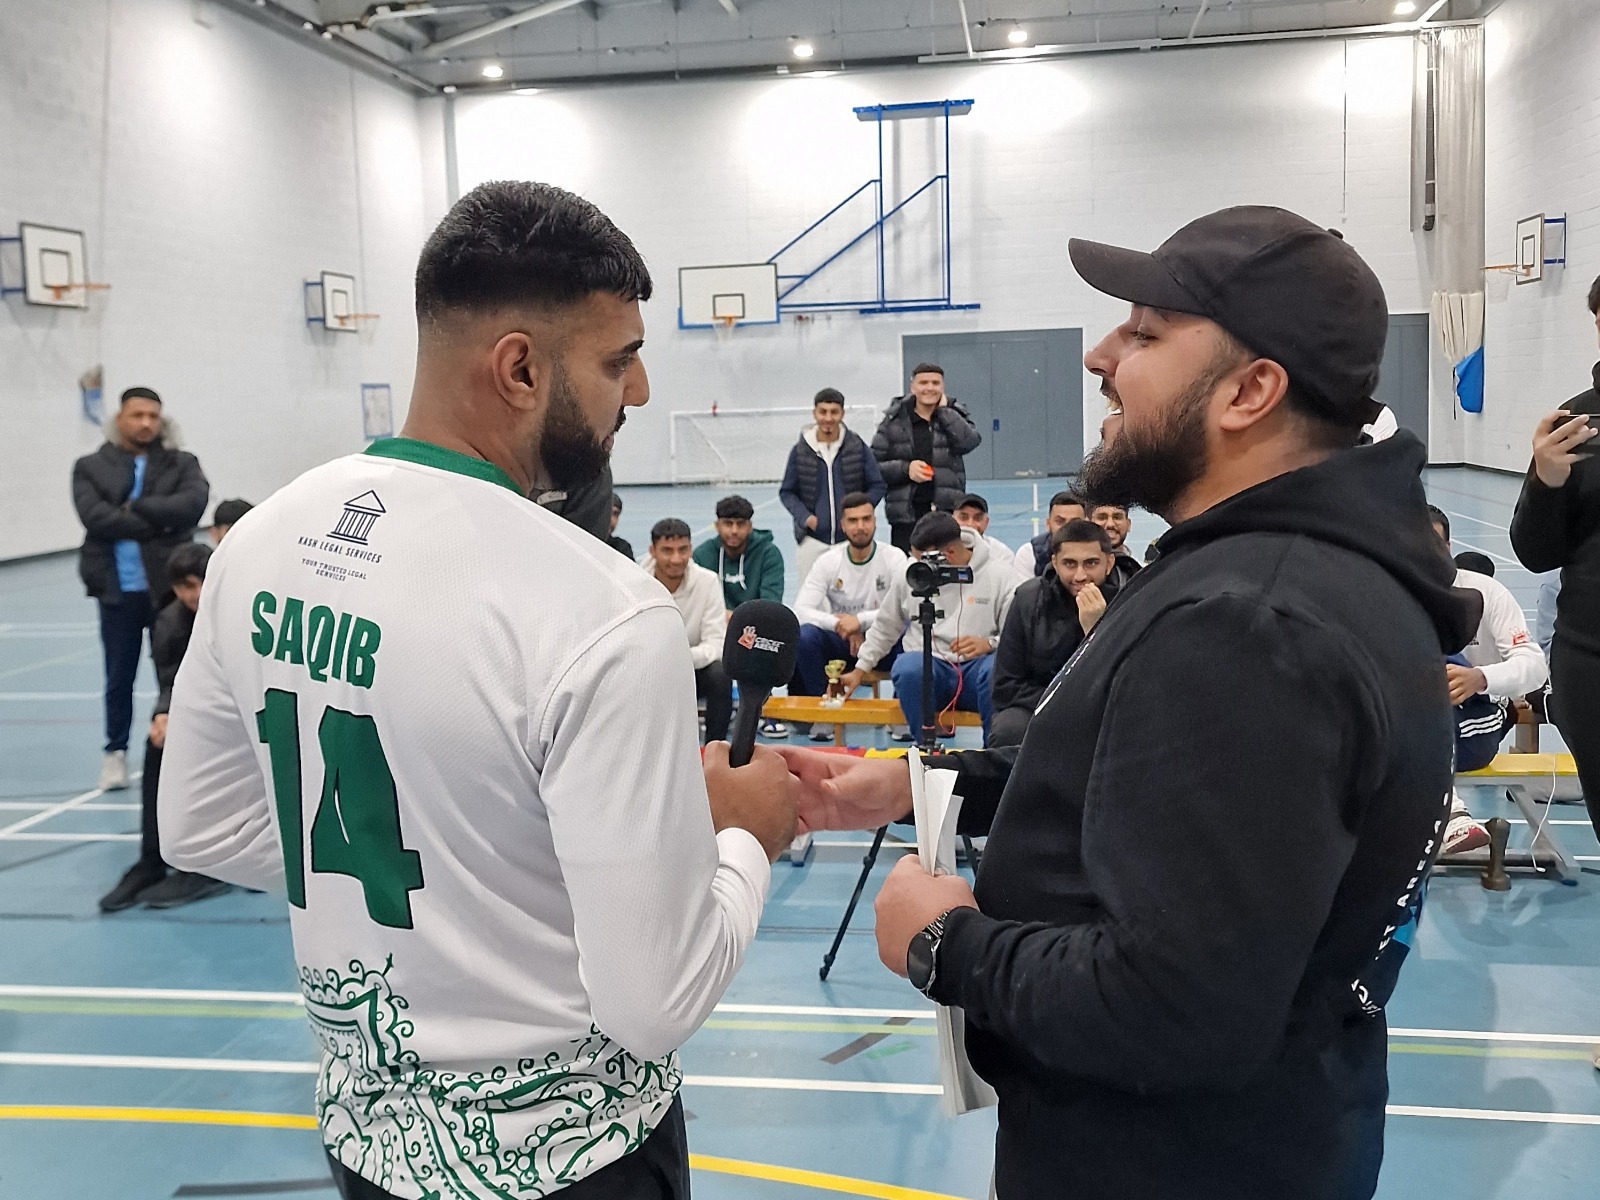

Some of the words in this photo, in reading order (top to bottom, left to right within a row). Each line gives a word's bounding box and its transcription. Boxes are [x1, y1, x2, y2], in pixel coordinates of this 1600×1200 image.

[298, 536, 318, 548] KASH
[320, 541, 343, 554] LEGAL
[345, 547, 382, 564] SERVICES
[302, 558, 318, 567] YOUR
[319, 562, 347, 575] TRUSTED
[348, 569, 367, 580] LEGAL
[251, 590, 382, 690] SAQIB
[255, 687, 425, 930] 14
